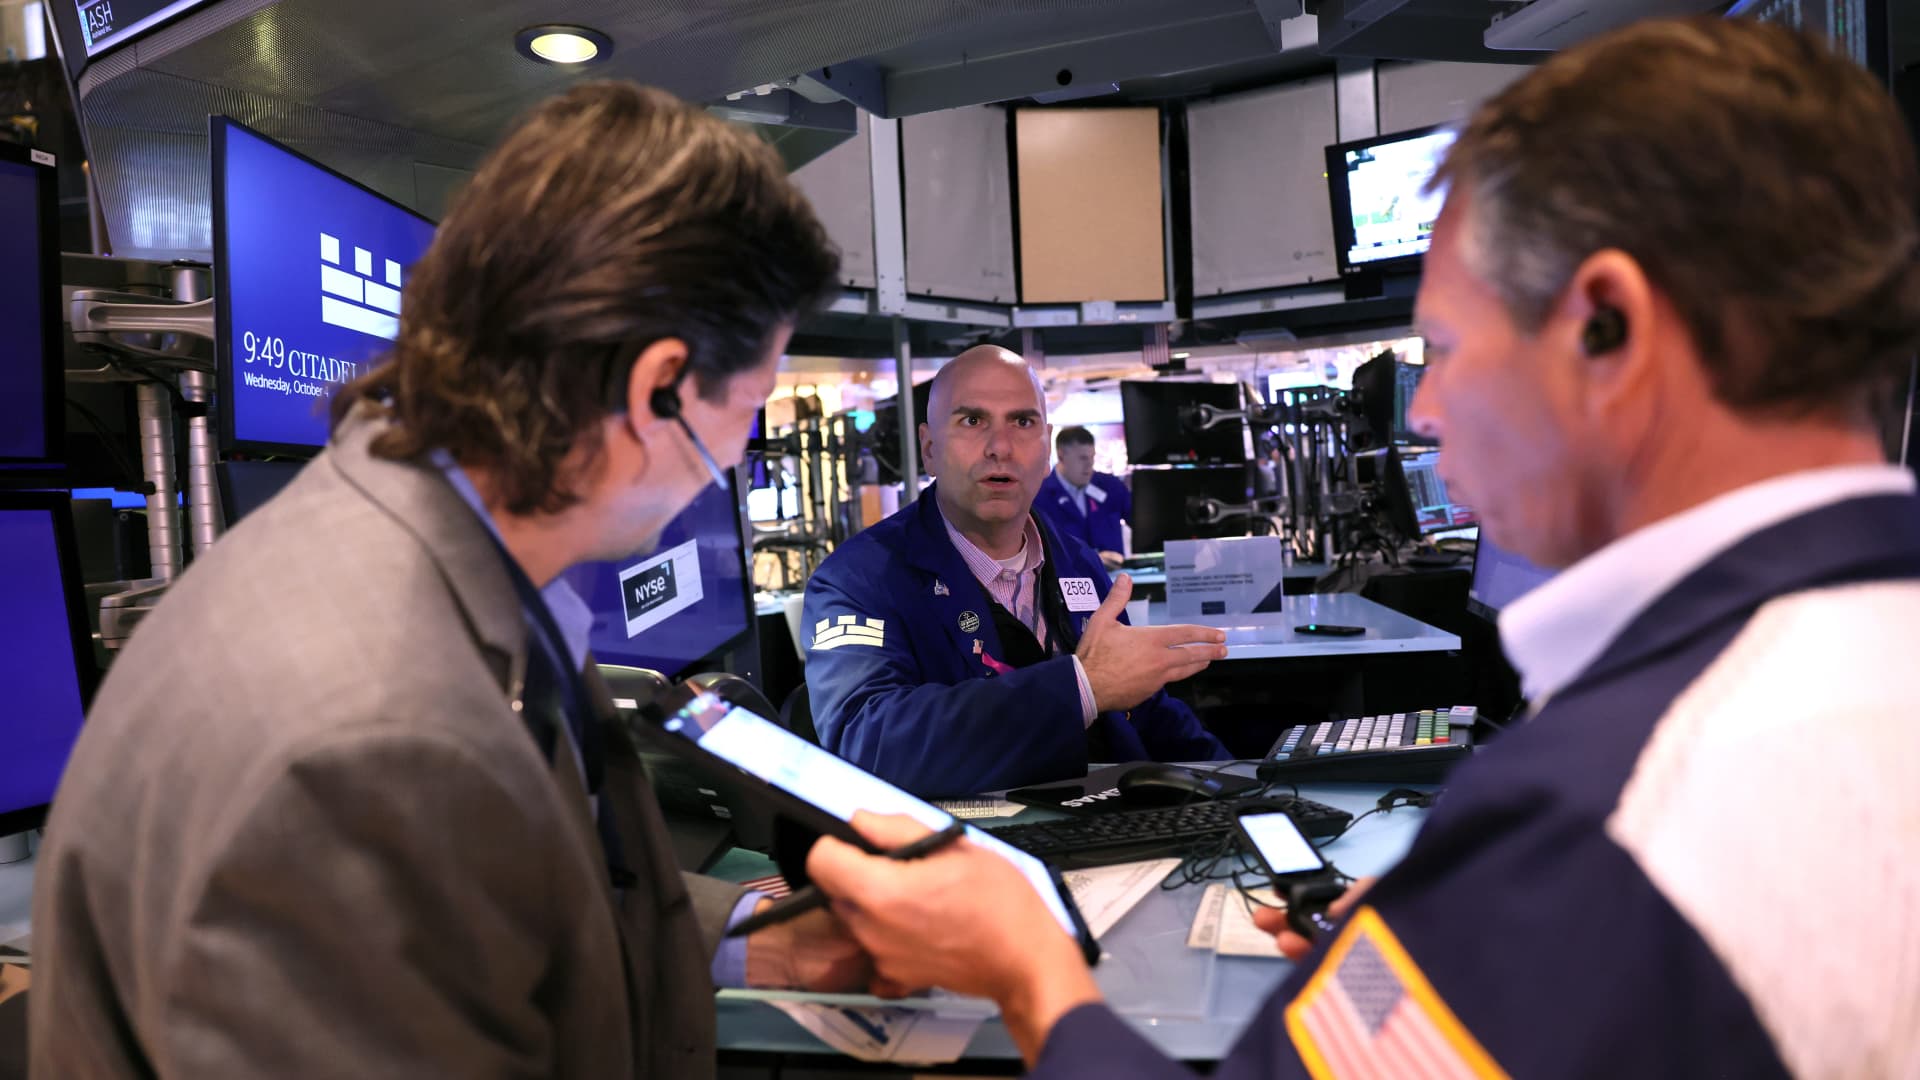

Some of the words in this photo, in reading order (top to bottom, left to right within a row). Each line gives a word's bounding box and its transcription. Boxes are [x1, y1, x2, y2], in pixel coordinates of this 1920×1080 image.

[89, 1, 113, 32] ASH
[243, 331, 285, 369] 9:49
[243, 371, 292, 395] Wednesday,
[293, 380, 322, 397] October
[1064, 581, 1093, 596] 2582
